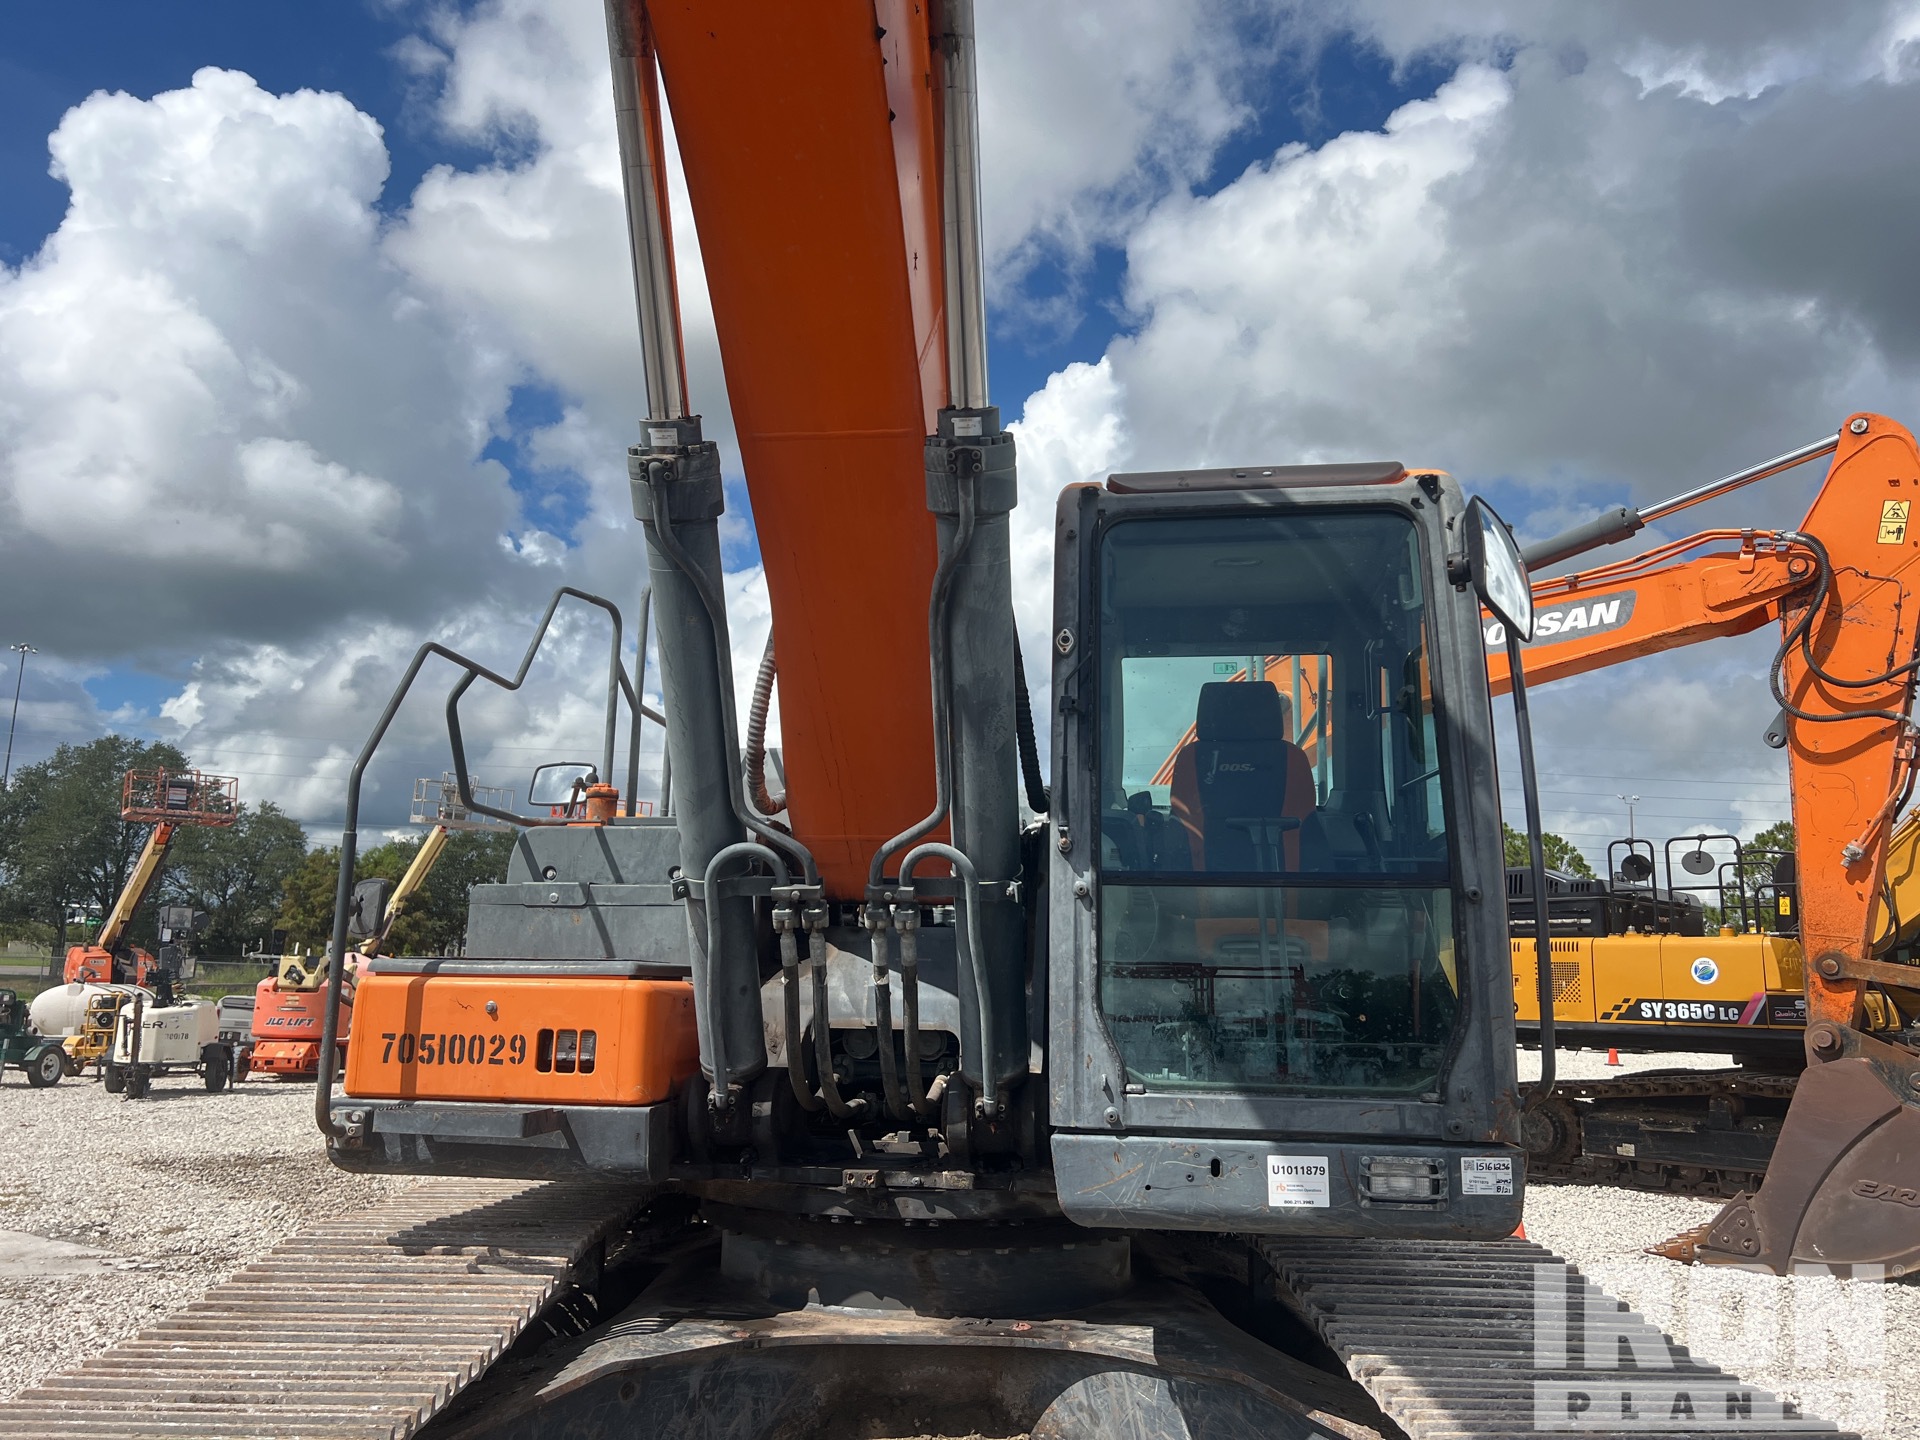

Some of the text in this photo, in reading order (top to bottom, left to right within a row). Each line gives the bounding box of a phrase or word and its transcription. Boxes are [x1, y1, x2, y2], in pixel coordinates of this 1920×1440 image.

[1483, 600, 1621, 646] OSAN
[1719, 1007, 1739, 1021] LC
[1774, 1010, 1797, 1019] Quality
[264, 1017, 316, 1027] JLG LIFT
[381, 1032, 527, 1066] 70510029
[1272, 1164, 1326, 1176] U1011879
